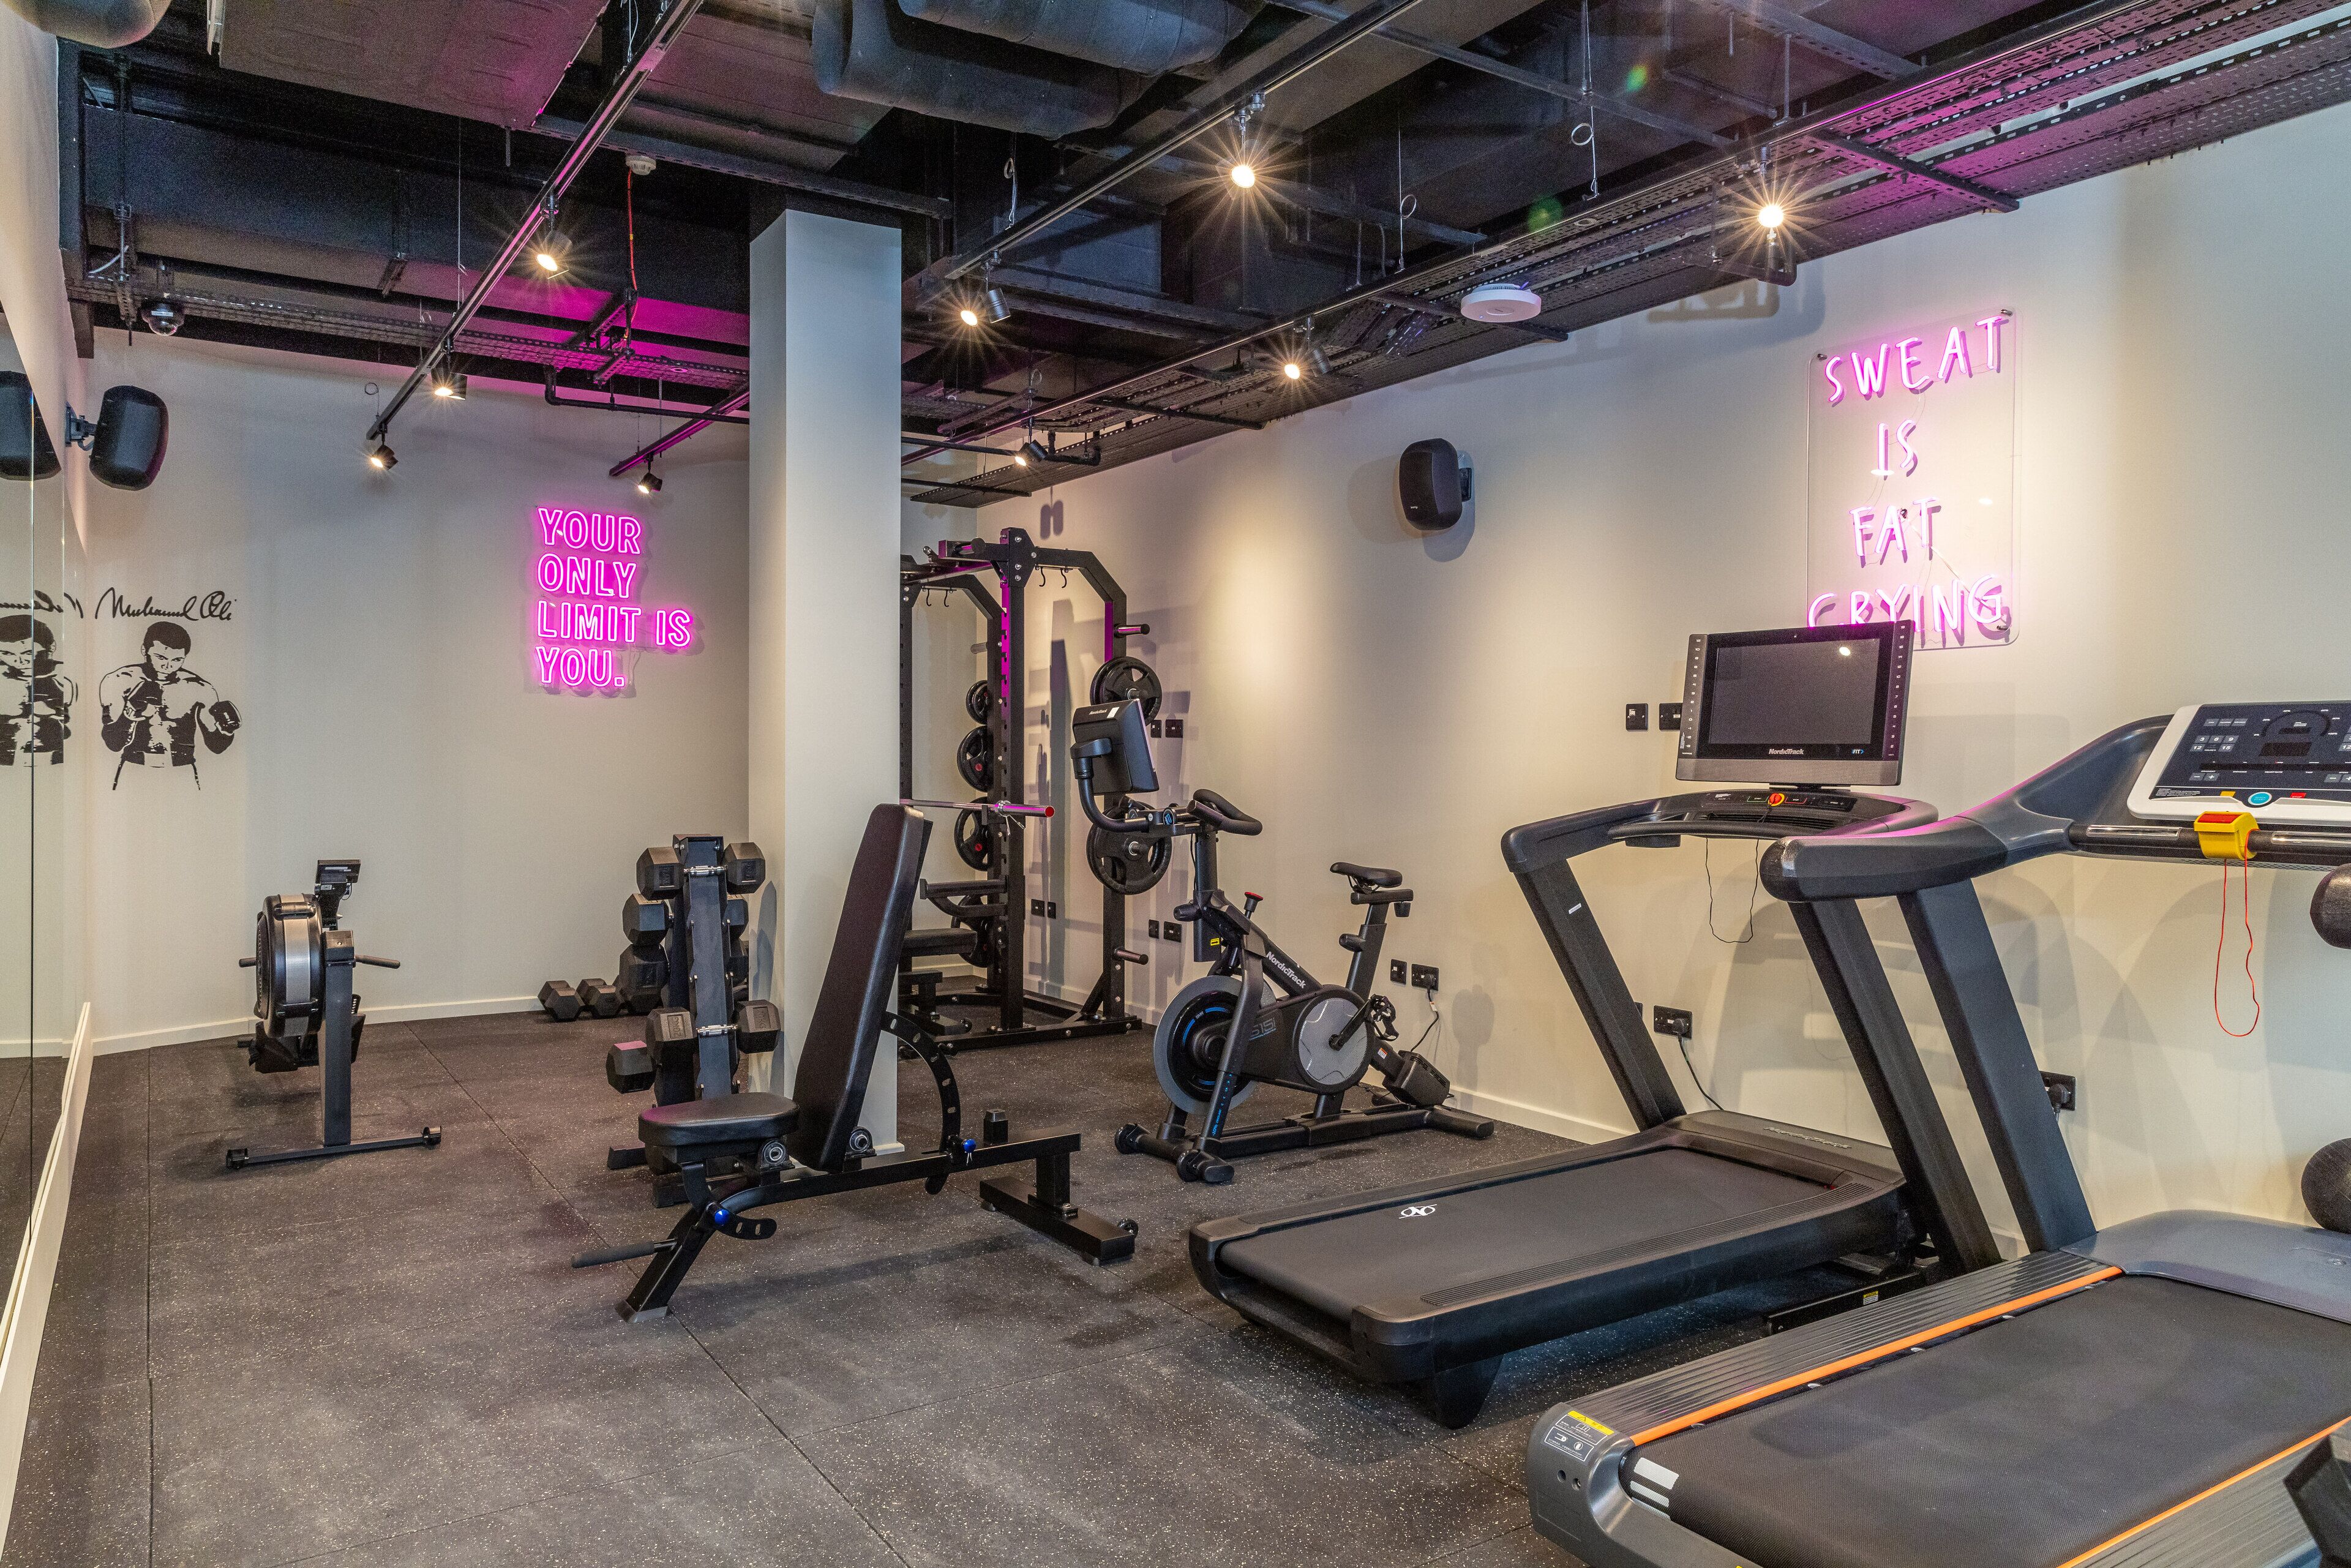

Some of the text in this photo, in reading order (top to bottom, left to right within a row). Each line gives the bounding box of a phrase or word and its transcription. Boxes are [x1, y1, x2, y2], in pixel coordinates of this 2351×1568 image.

[1824, 315, 2003, 403] SWEAT
[1877, 419, 1916, 470] IS
[538, 507, 642, 555] YOUR
[1849, 497, 1940, 556] FAT
[538, 553, 637, 599] ONLY
[538, 600, 691, 647] LIMIT IS
[1808, 573, 2004, 633] CRYING
[536, 645, 625, 687] YOU.
[1265, 951, 1307, 989] NordicTrack
